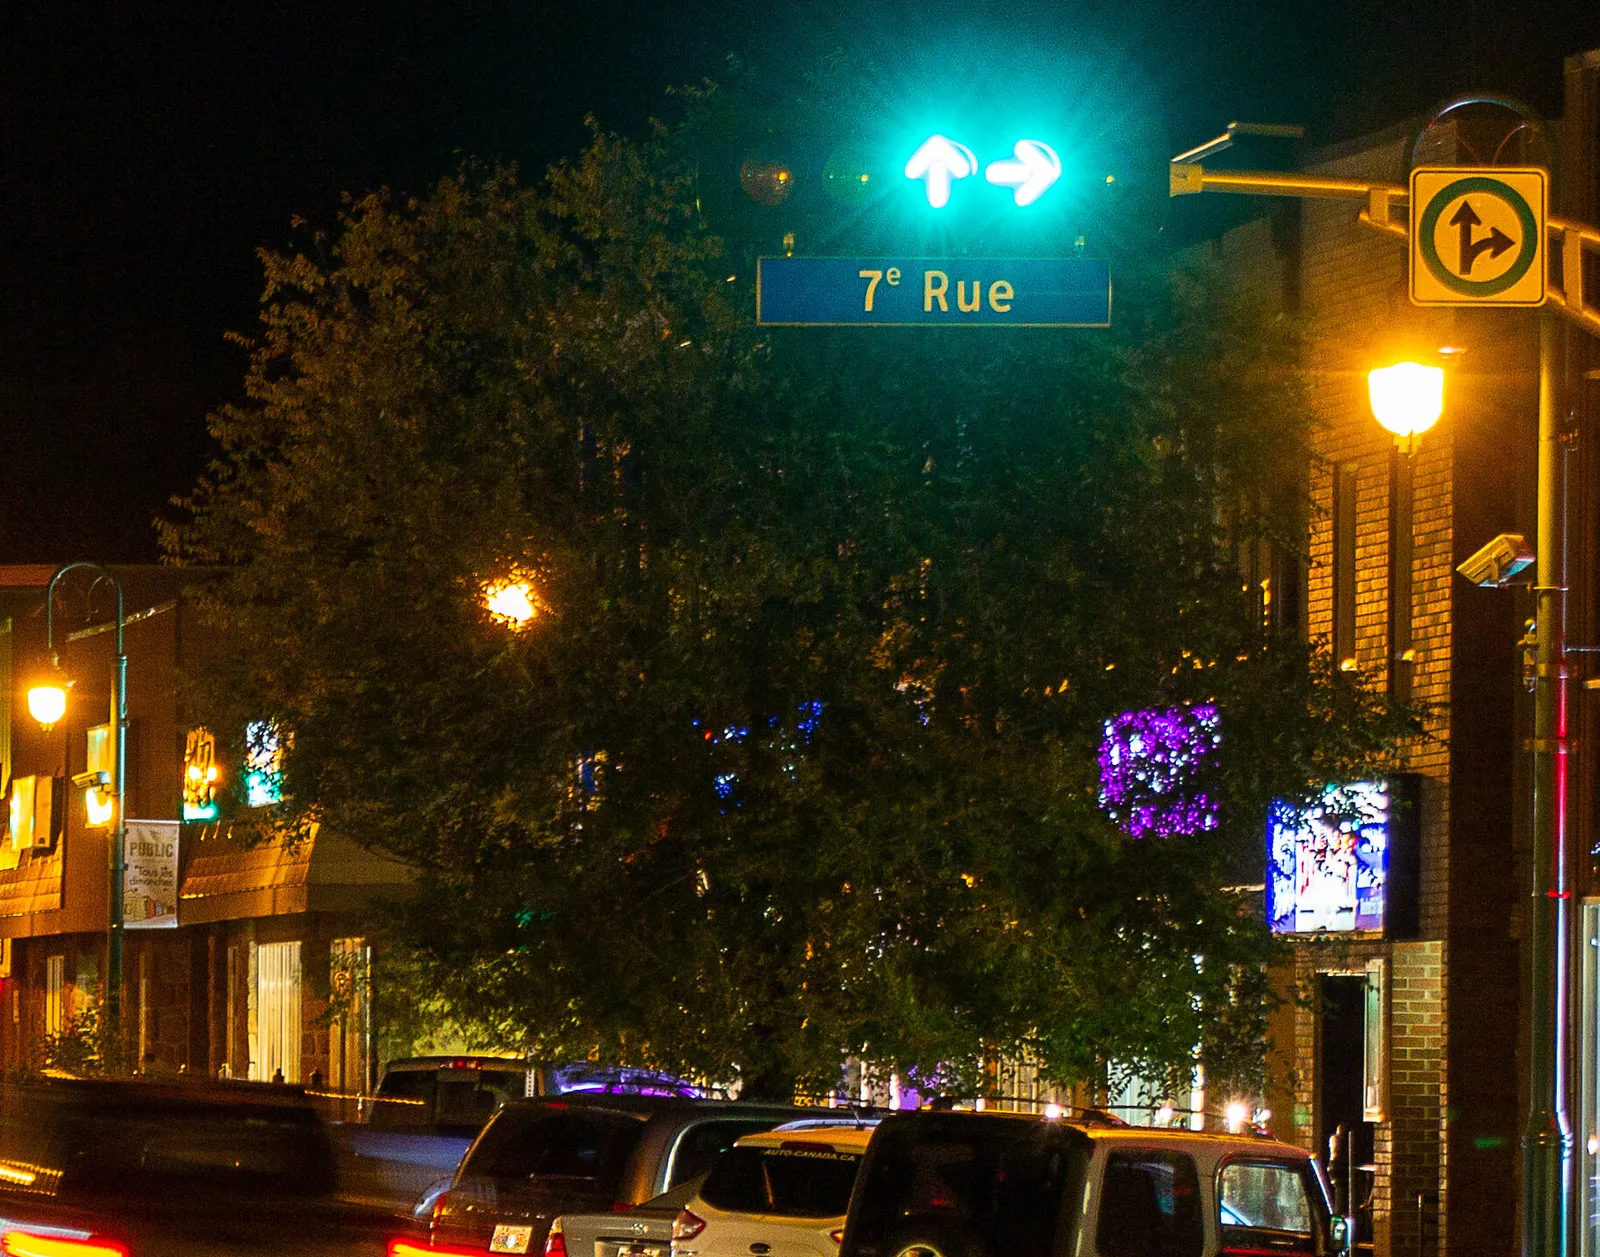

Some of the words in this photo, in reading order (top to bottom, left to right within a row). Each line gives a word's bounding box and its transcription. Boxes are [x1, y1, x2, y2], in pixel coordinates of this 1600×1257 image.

[859, 267, 901, 312] 7e
[924, 270, 1014, 313] Rue
[129, 842, 174, 858] PUBLIC
